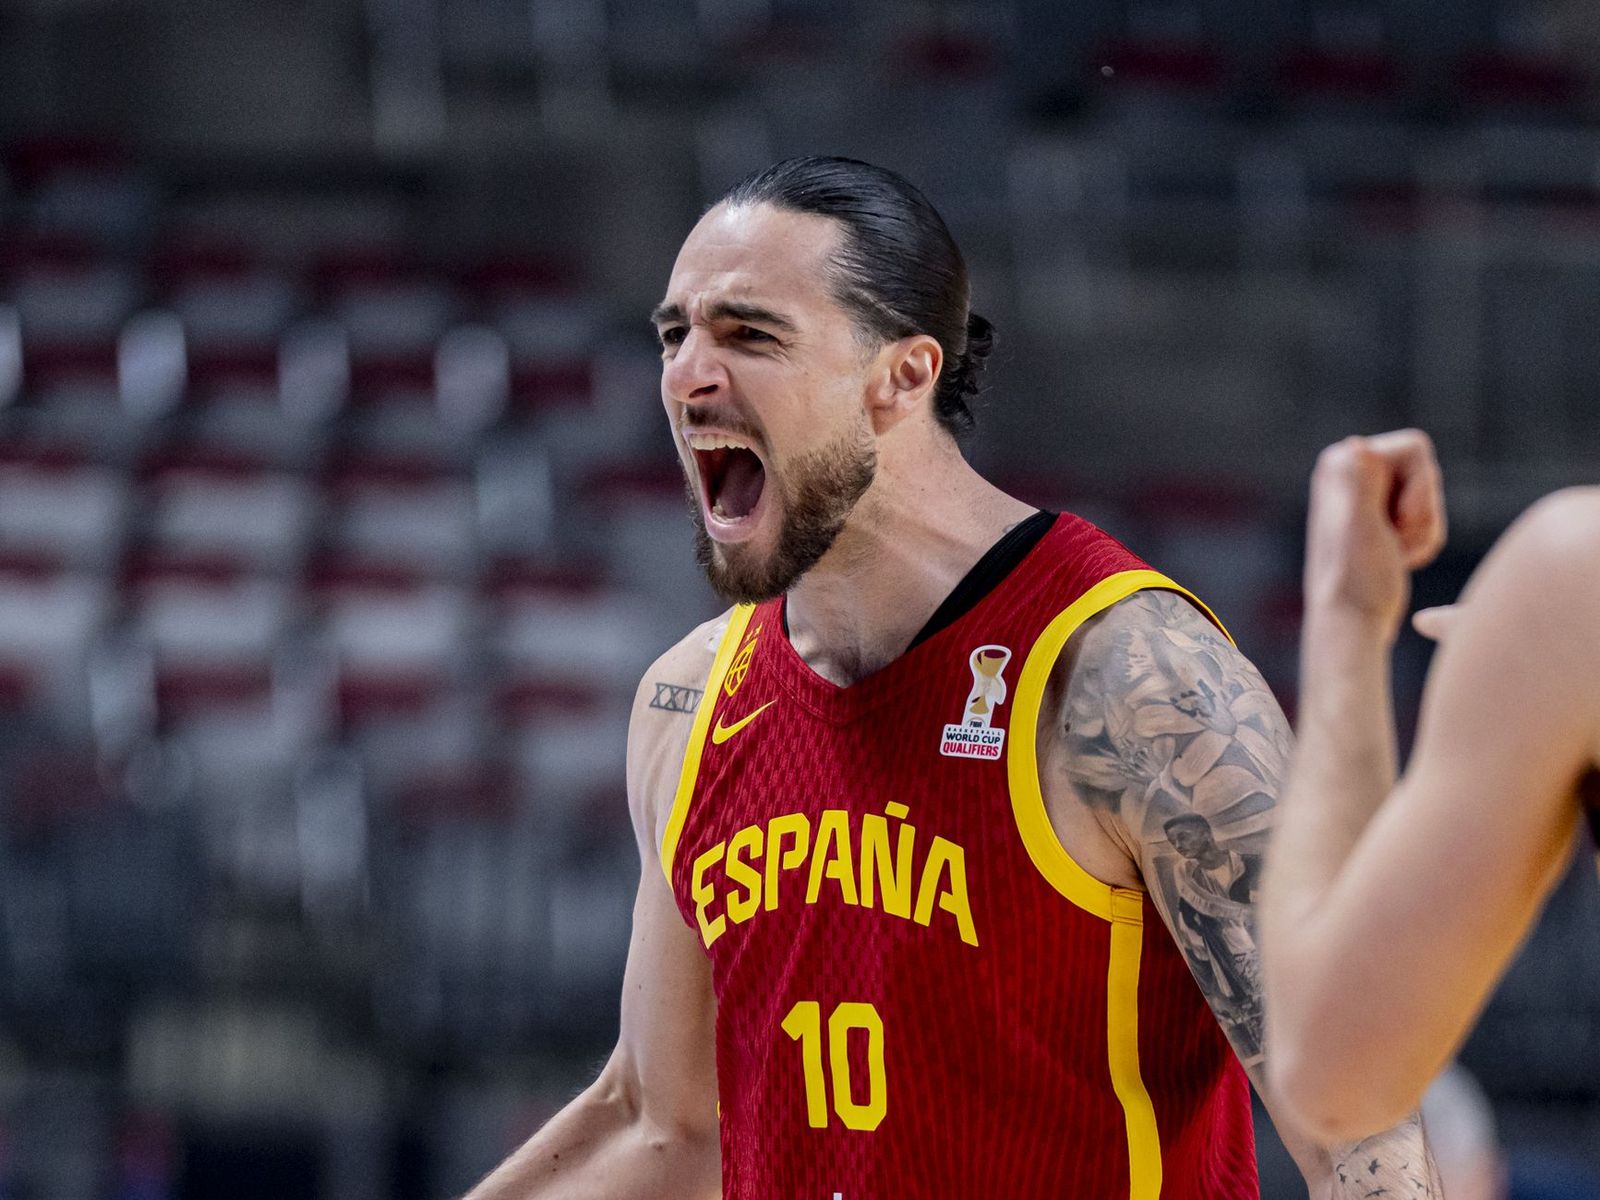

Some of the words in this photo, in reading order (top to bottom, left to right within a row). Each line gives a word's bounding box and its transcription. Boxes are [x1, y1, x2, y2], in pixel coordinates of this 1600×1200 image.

[943, 742, 999, 756] QUALIFIERS
[946, 733, 980, 742] WORLD
[982, 736, 1000, 744] CUP
[691, 800, 979, 950] ESPAÑA
[780, 1001, 888, 1132] 10
